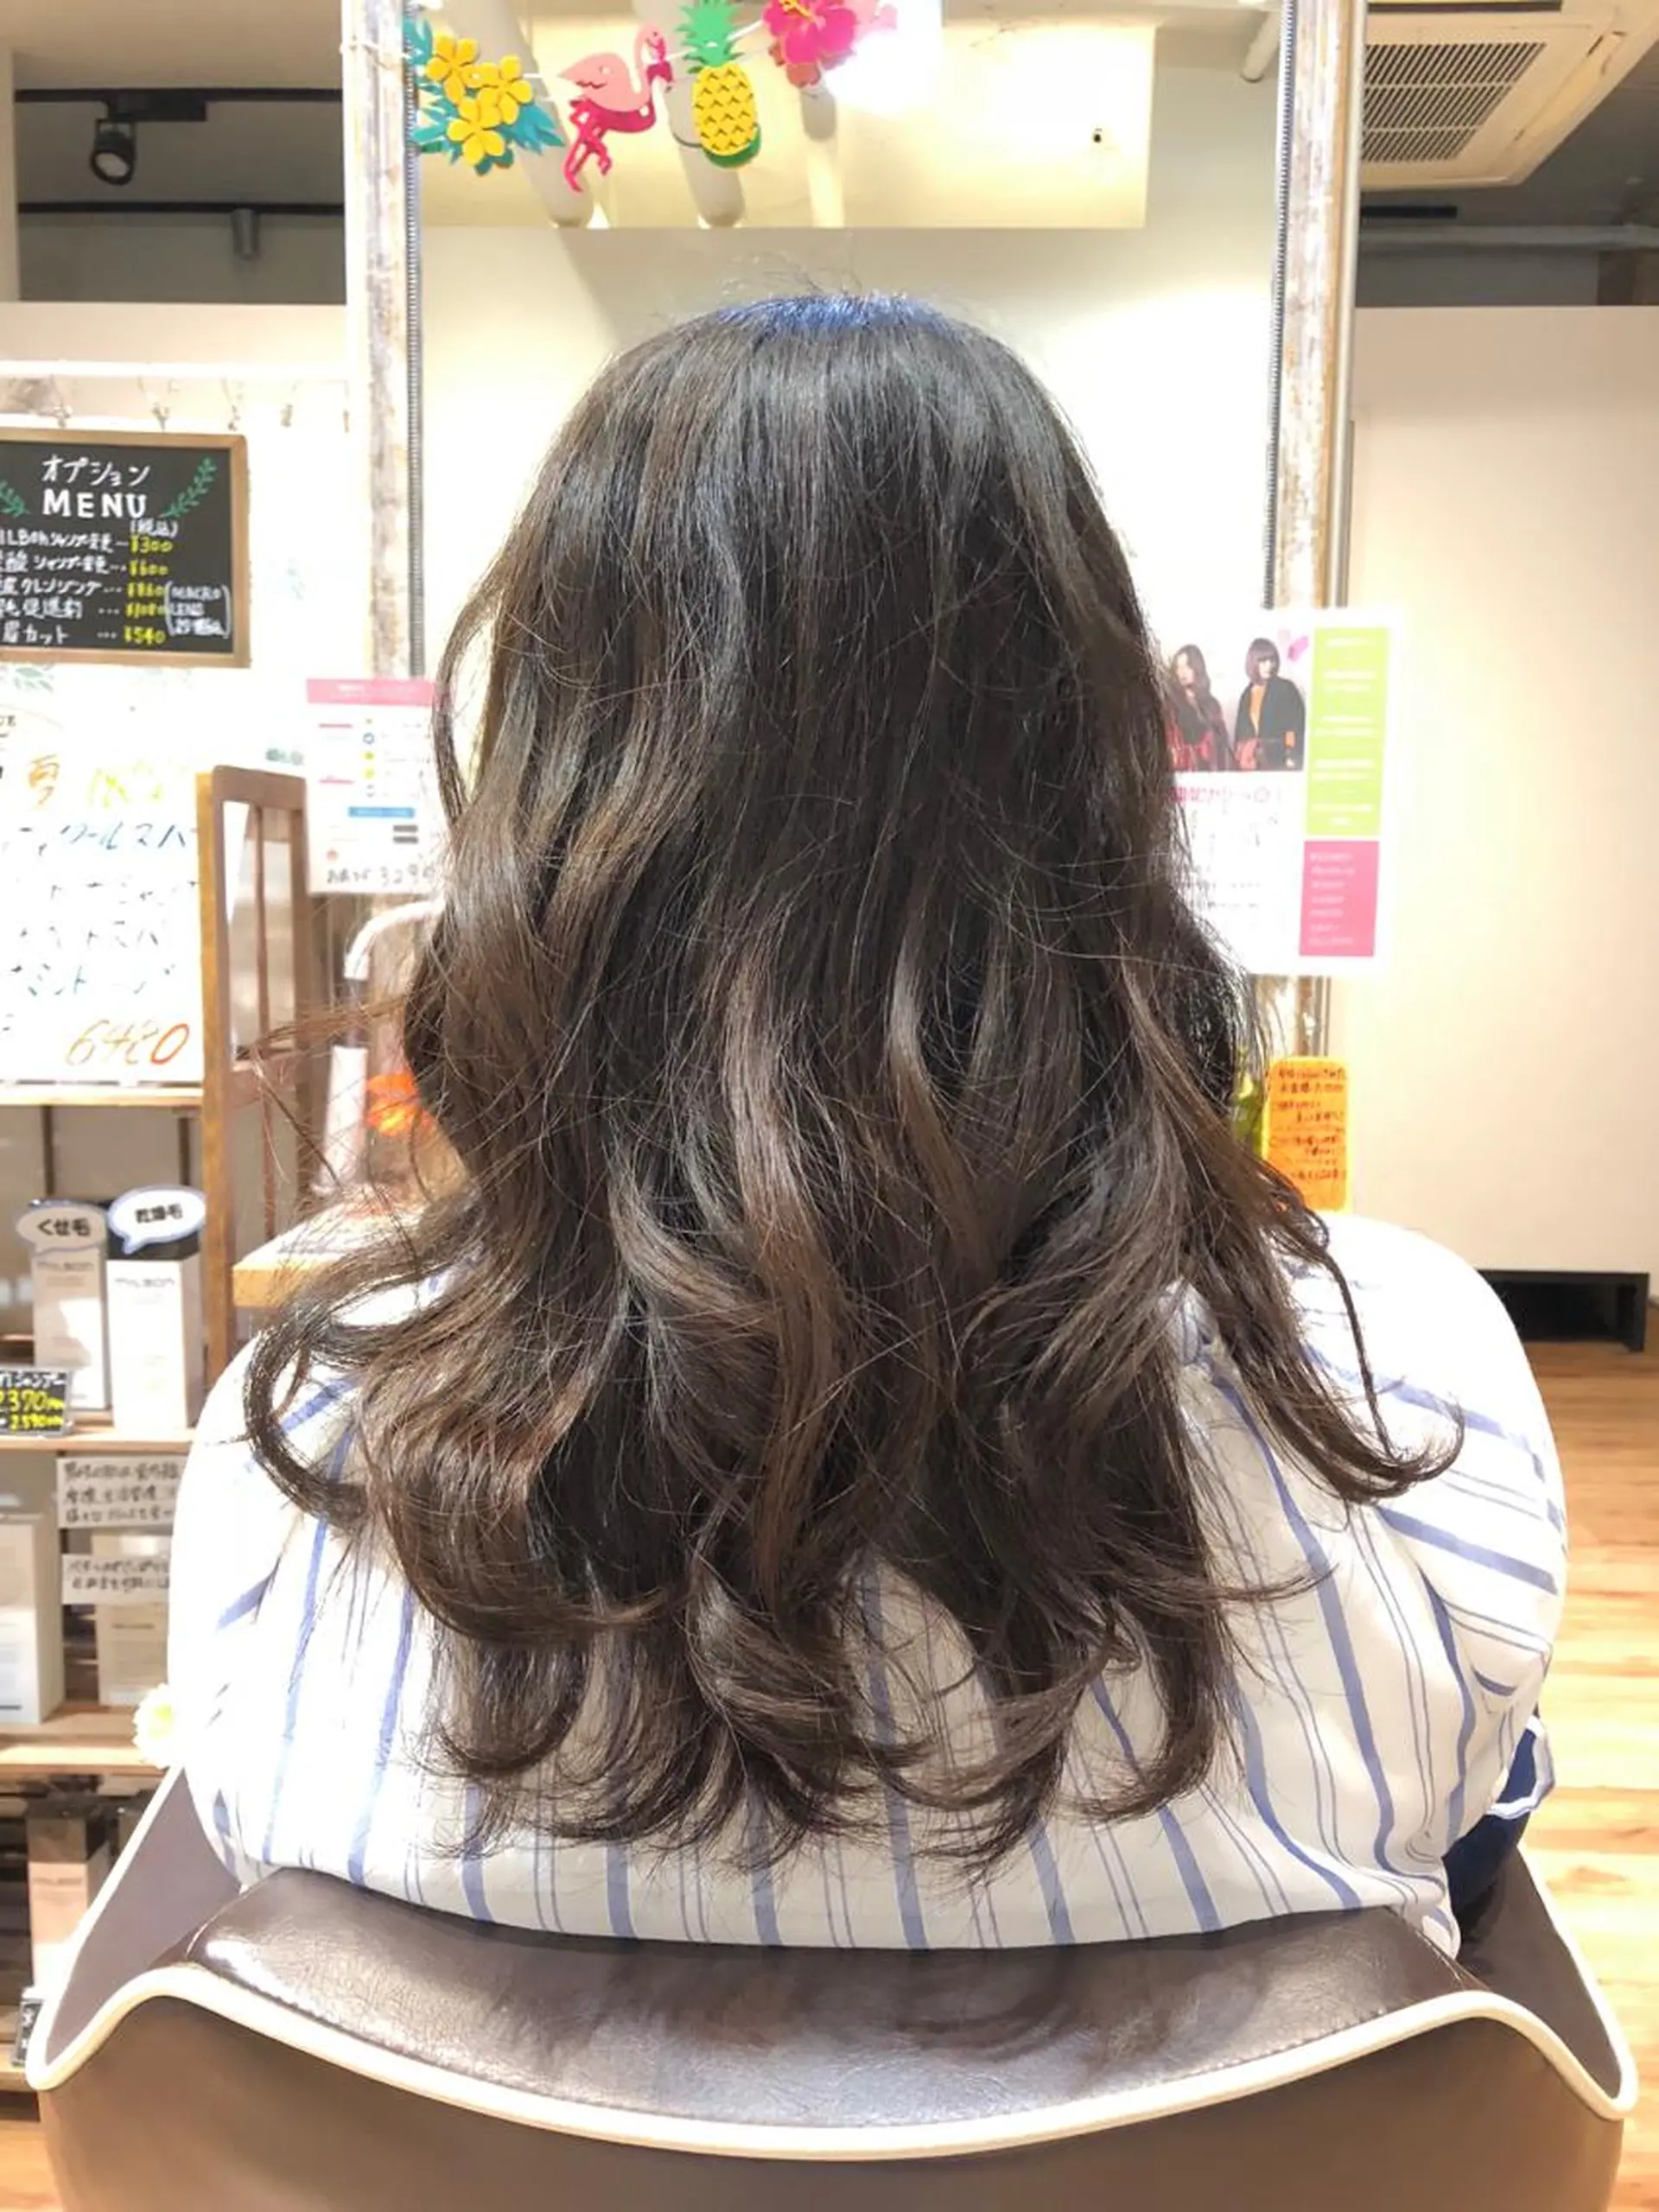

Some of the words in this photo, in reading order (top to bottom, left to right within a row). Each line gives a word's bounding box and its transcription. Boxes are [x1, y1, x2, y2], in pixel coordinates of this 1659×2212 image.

[42, 454, 150, 486] オプション
[42, 488, 148, 518] MENU
[124, 625, 166, 645] ¥540
[65, 1019, 190, 1065] 6480
[37, 1217, 91, 1237] くせ毛
